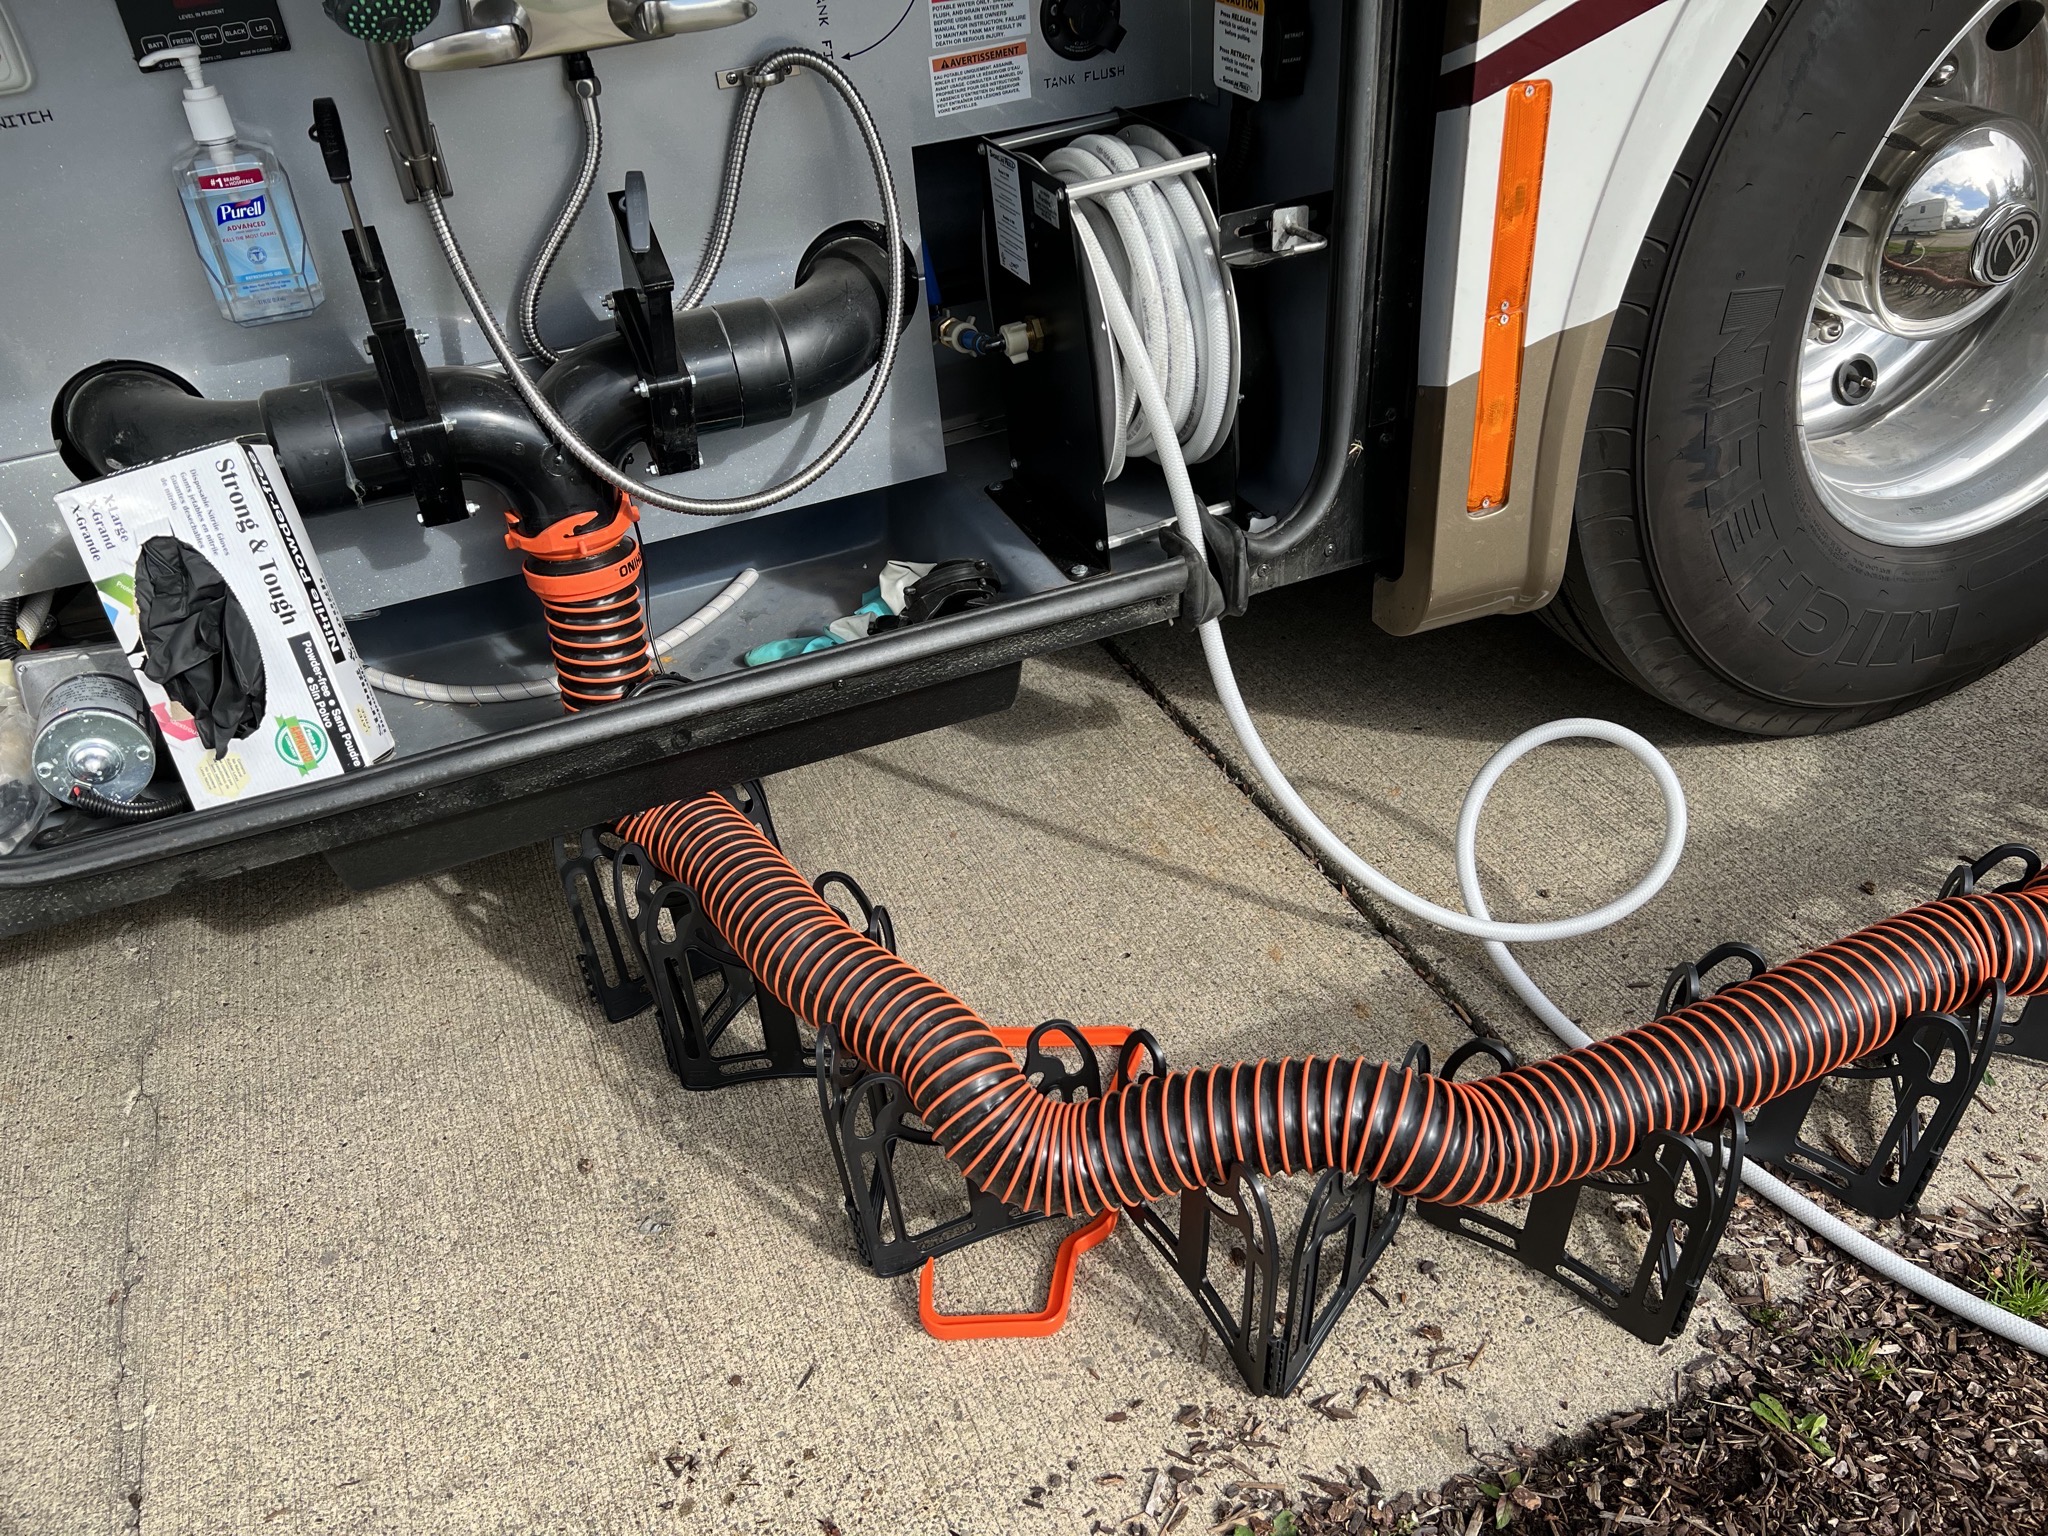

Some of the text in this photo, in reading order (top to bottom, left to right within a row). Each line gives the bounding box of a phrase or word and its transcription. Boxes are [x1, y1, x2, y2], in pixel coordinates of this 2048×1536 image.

[201, 8, 225, 16] PERCENT
[932, 3, 956, 12] POTABLE
[932, 12, 951, 20] FLUSH,
[981, 4, 1000, 12] WATER
[934, 18, 954, 26] BEFORE
[984, 10, 1006, 18] OWNERS
[1005, 14, 1026, 22] FAILURE
[1220, 10, 1230, 18] Press
[1232, 13, 1251, 24] RELEASE
[224, 27, 246, 37] BLACK
[255, 24, 269, 32] LPG
[943, 30, 968, 39] MAINTAIN
[1219, 20, 1231, 28] switch
[1237, 25, 1249, 34] unlock
[1225, 28, 1236, 38] before
[172, 36, 194, 46] FRESH
[200, 32, 218, 41] GREY
[936, 38, 952, 47] DEATH
[986, 32, 1005, 40] INJURY.
[148, 41, 164, 49] BATT
[950, 46, 1020, 68] AVERTISSEMENT
[1220, 46, 1230, 54] Press
[1230, 49, 1251, 61] RETRACT
[1222, 56, 1233, 64] switch
[1282, 56, 1301, 64] RELEASE
[966, 76, 992, 85] CONSULTER
[1044, 66, 1124, 88] TANK FLUSH
[936, 87, 966, 98] PROPRIÉTAIRE
[961, 89, 988, 98] D'ENTRETIEN
[210, 178, 223, 187] #1
[229, 178, 254, 186] HOSPITALS
[221, 201, 261, 220] Purell
[227, 220, 266, 232] ADVANCED
[1700, 286, 1960, 668] MICHELIN
[161, 477, 177, 511] de nitrilo
[103, 494, 129, 542] X-Large
[170, 475, 204, 549] Guantes desechables
[180, 472, 218, 556] Gants jetables en nitrile
[190, 469, 229, 556] Disposable Nitrile Gloves
[86, 500, 116, 550] X-Grand
[71, 505, 101, 561] X-Grande
[216, 458, 297, 626] Strong & Tough
[248, 450, 340, 652] Nitrile Powder-free
[302, 640, 361, 767] Powder-free Sans Poudre
[309, 683, 333, 729] Sin Polvo
[290, 726, 313, 763] APPROVED
[306, 728, 316, 746] PROP
